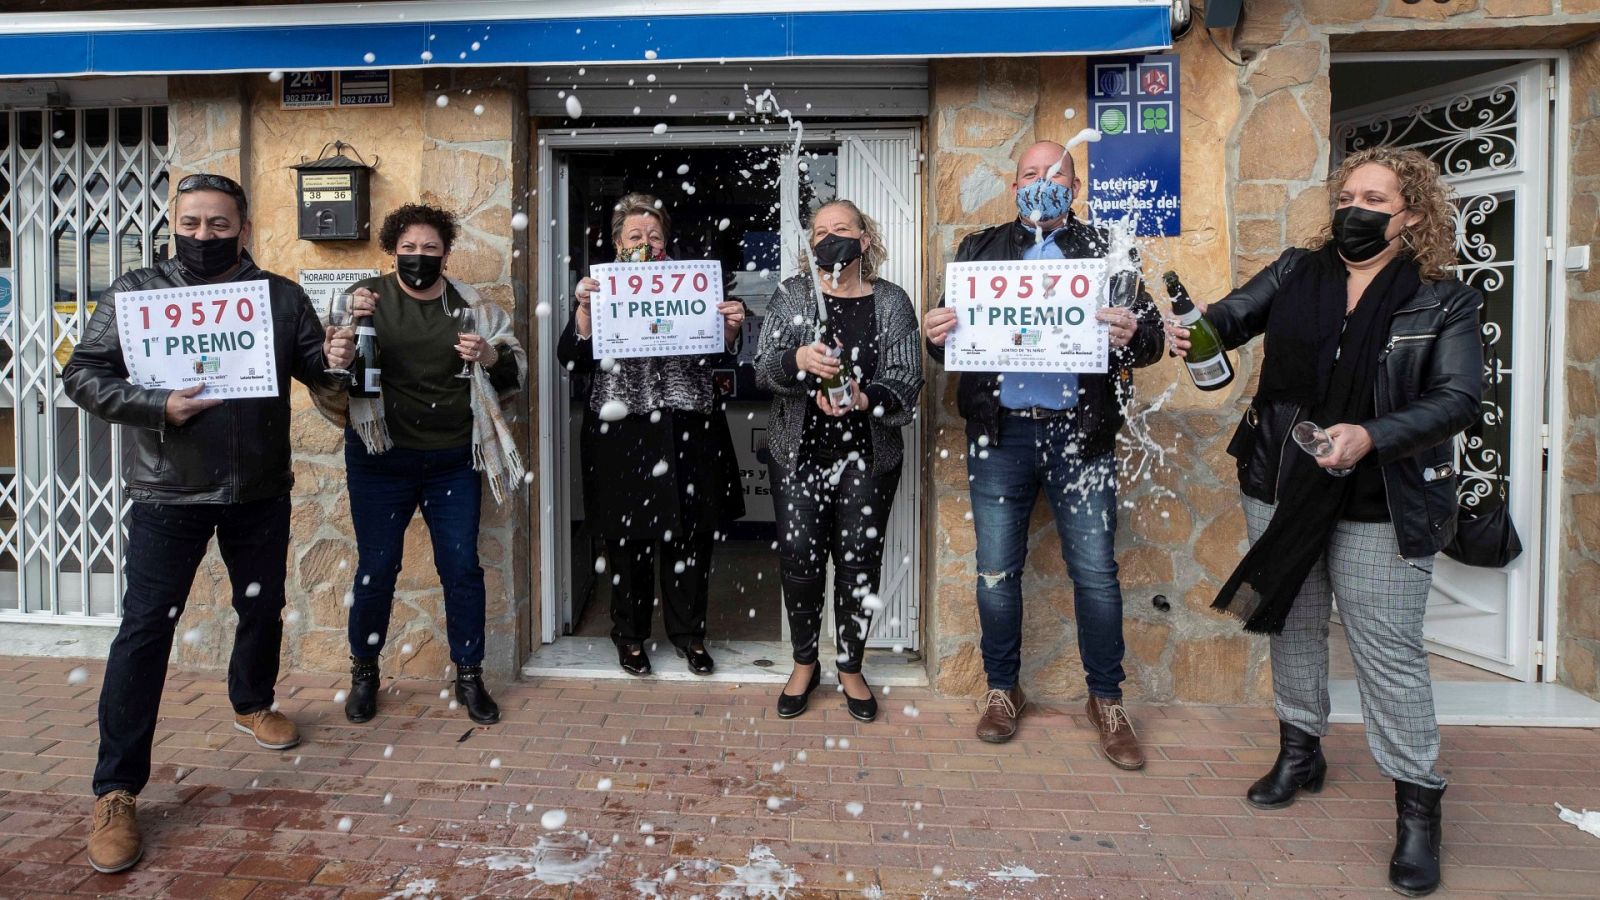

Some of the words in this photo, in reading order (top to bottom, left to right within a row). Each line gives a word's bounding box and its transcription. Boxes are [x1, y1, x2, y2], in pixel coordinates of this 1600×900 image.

[1093, 178, 1146, 190] Loterías
[1150, 180, 1158, 192] y
[1093, 198, 1153, 212] Apuestas
[1157, 196, 1178, 208] del
[304, 274, 334, 282] HORARIO
[336, 272, 372, 280] APERTURA
[608, 272, 708, 296] 19570
[968, 274, 1090, 299] 19570
[140, 298, 254, 329] 19570
[628, 300, 706, 318] PREMIO
[989, 306, 1084, 326] PREMIO
[166, 330, 255, 356] PREMIO
